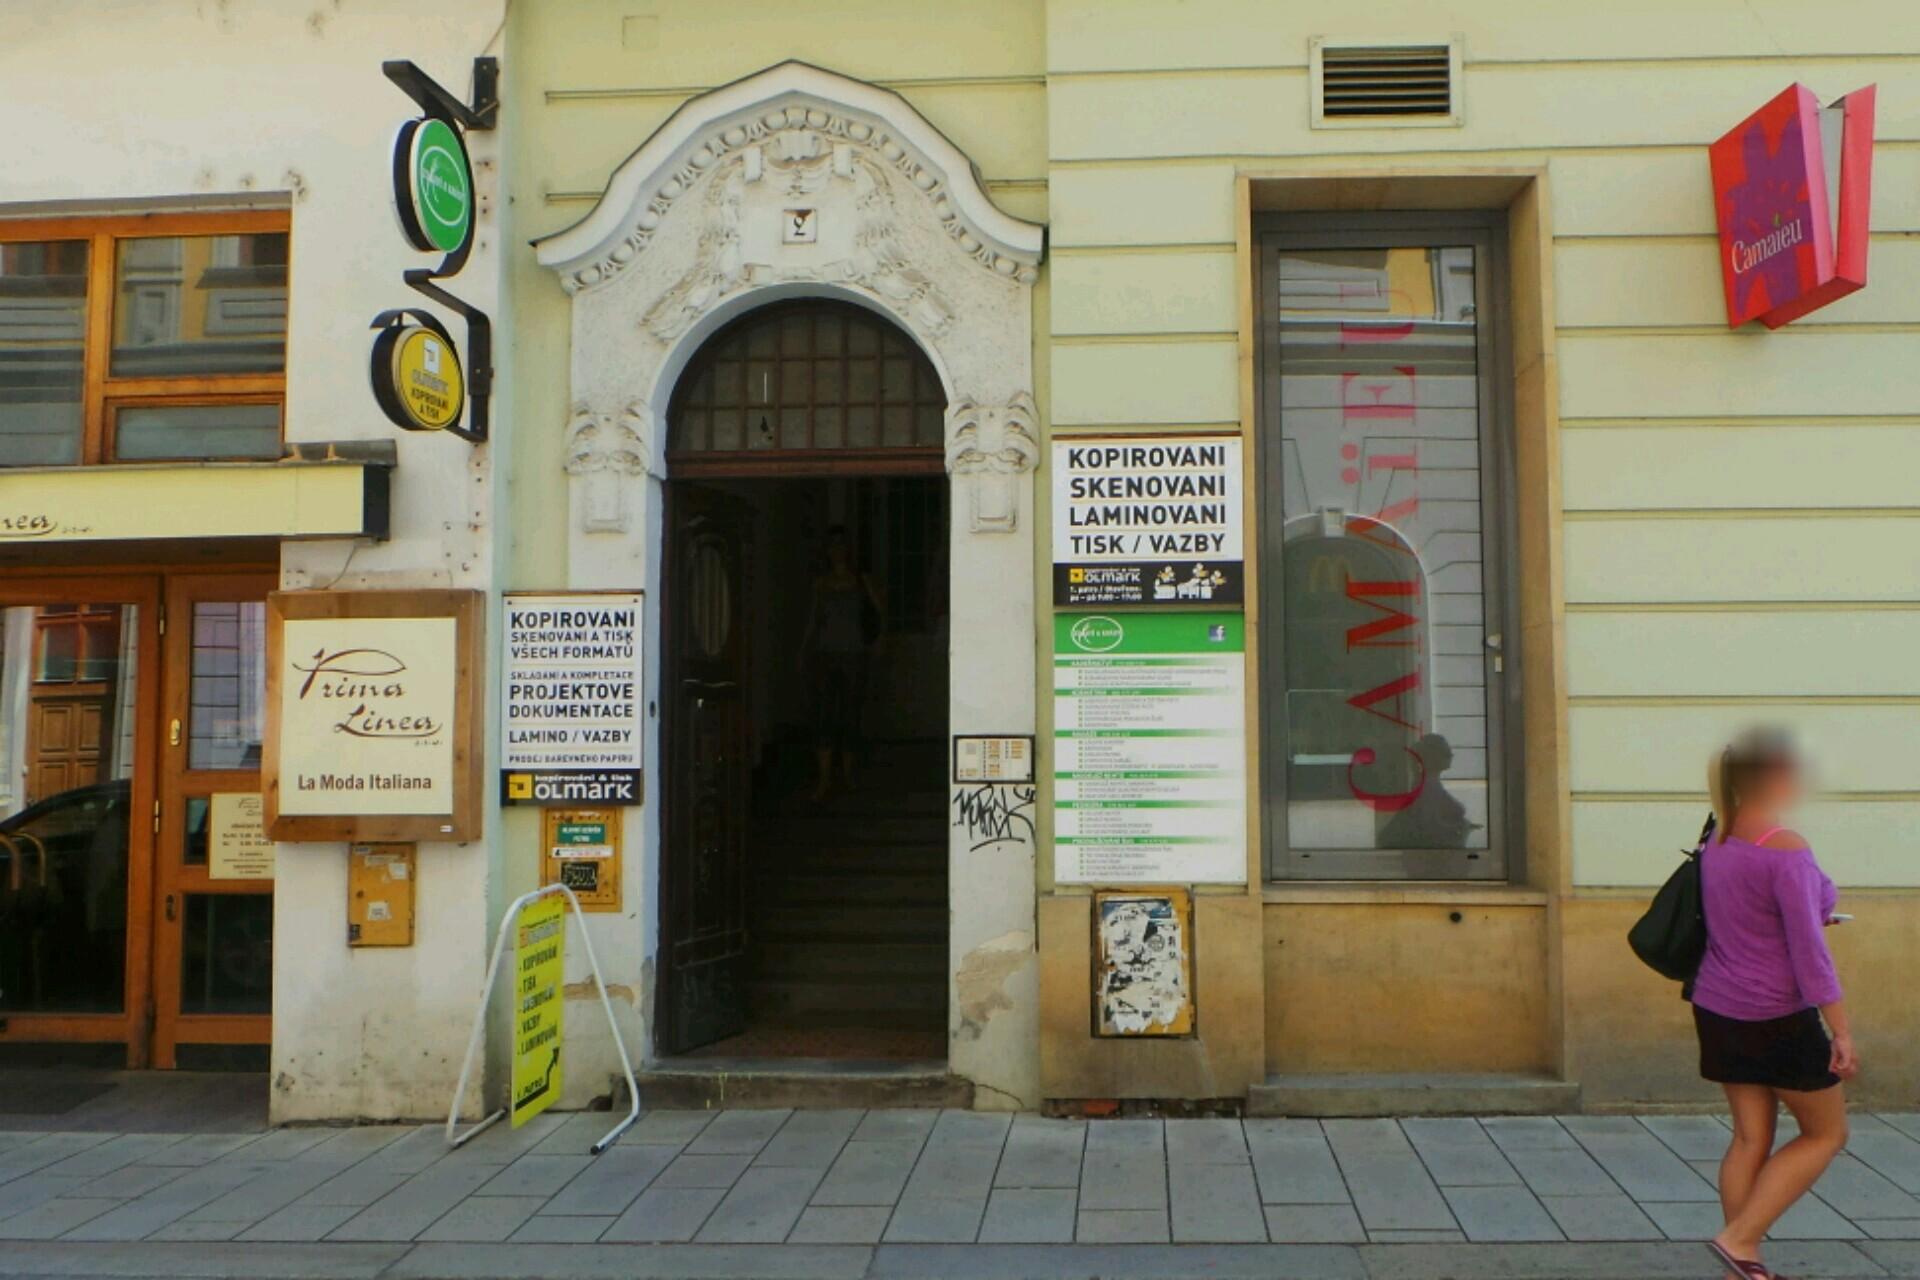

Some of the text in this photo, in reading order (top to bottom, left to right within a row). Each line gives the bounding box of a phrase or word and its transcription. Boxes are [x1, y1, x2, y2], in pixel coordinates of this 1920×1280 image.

[1070, 535, 1125, 554] TISK
[1150, 533, 1225, 553] VAZBY
[591, 631, 600, 642] A
[604, 629, 634, 642] TISK
[509, 703, 633, 718] DOKUMENTACE
[509, 730, 568, 743] LAMINO
[582, 729, 632, 743] VAZBY
[298, 773, 432, 790] La Moda Italiana
